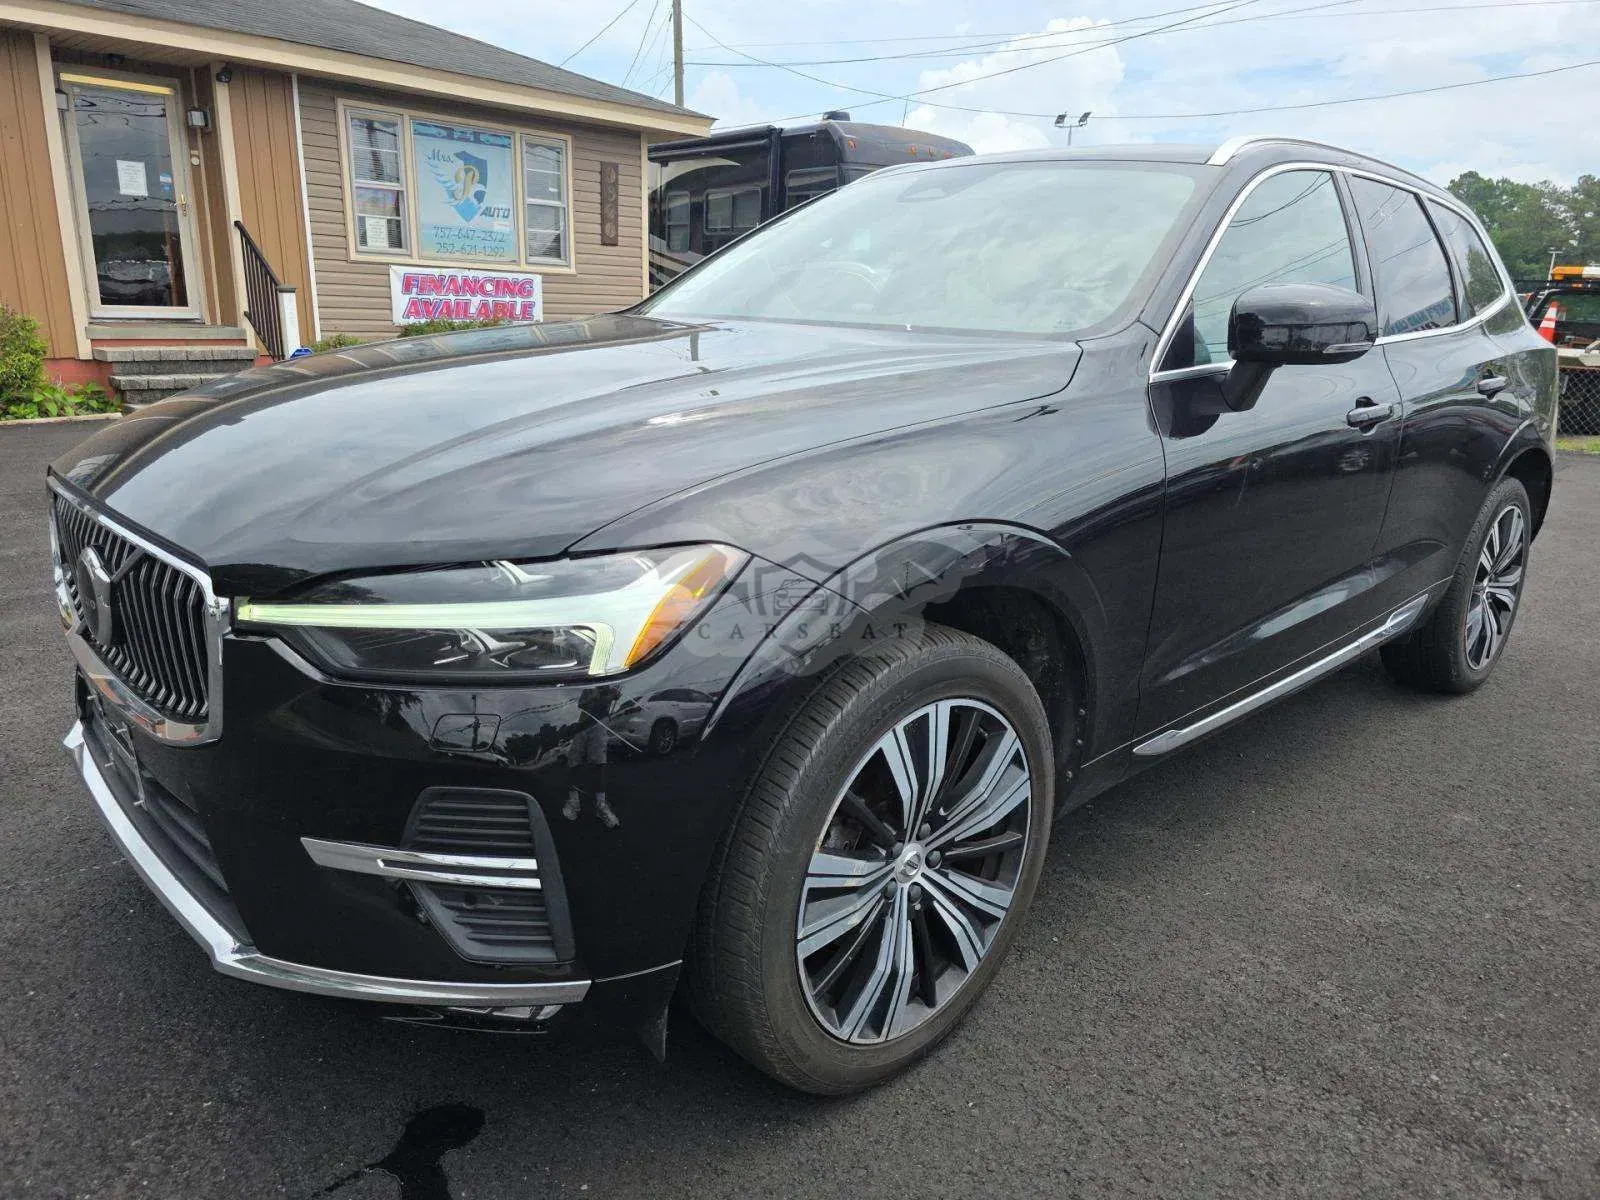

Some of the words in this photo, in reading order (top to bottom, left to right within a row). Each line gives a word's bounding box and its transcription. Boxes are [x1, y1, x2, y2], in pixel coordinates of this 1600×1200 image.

[427, 148, 454, 164] Mrs.
[480, 206, 511, 219] AUTO
[401, 272, 534, 299] FINANCING
[403, 297, 536, 321] AVAILABLE
